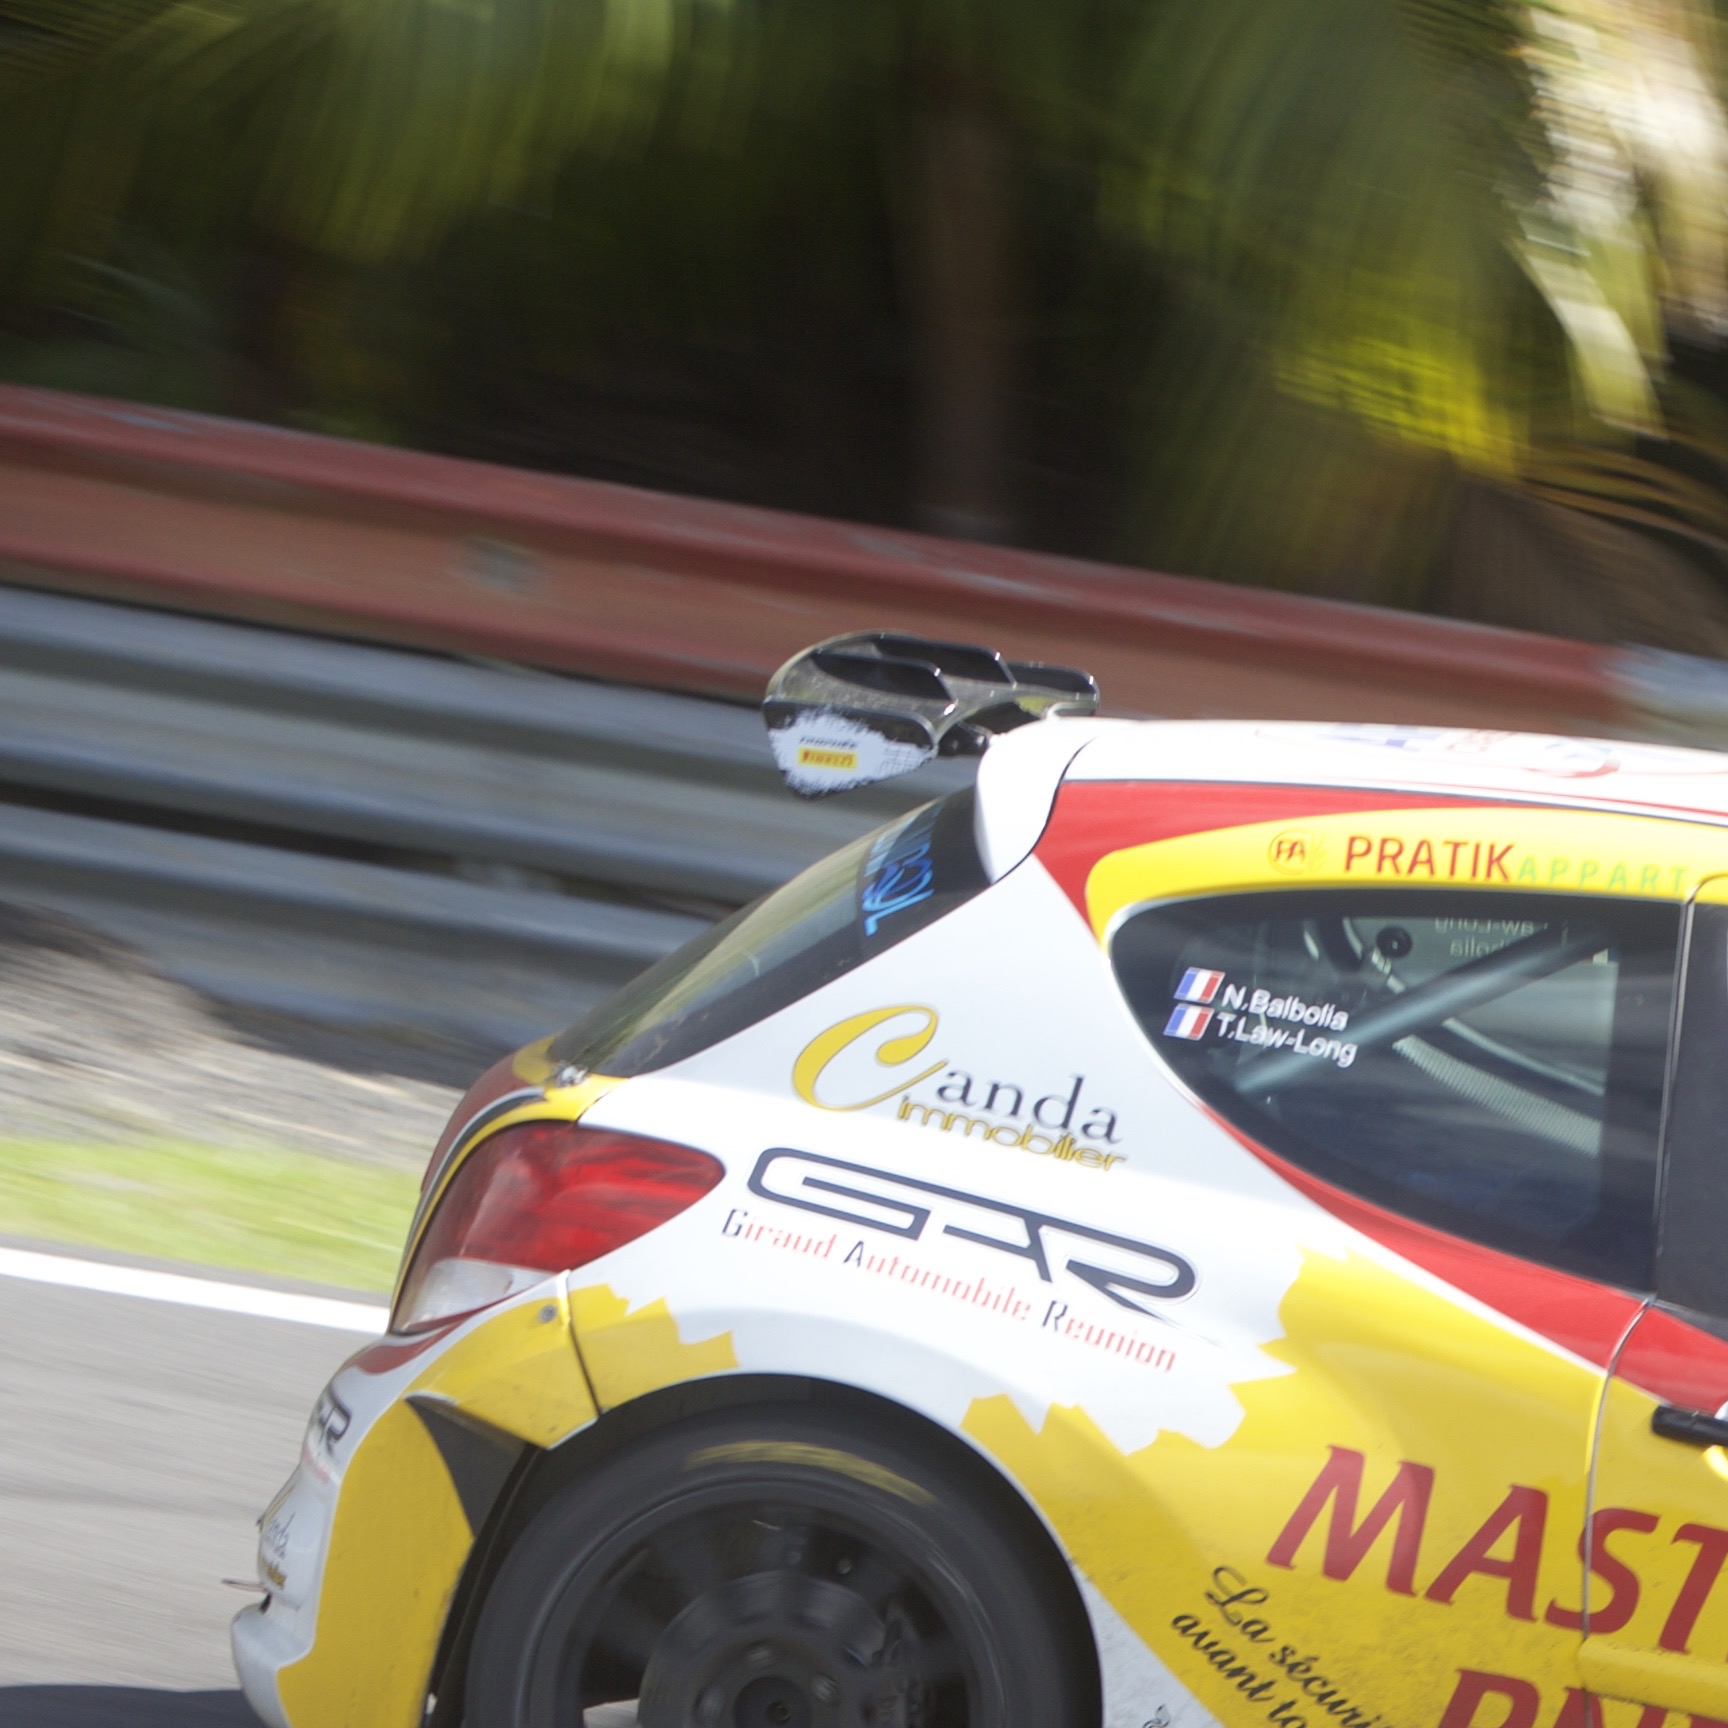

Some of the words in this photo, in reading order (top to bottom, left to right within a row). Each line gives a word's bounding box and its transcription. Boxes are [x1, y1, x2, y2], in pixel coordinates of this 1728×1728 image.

[1343, 835, 1516, 882] PRATIK
[1516, 857, 1691, 895] APPART
[790, 1003, 1122, 1146] Canda
[1216, 1011, 1358, 1069] T.Law-Long
[896, 1094, 1128, 1172] immobilier
[720, 1207, 840, 1263] Giraud
[842, 1239, 1034, 1326] Automobile
[1041, 1299, 1179, 1375] Reunion
[1204, 1565, 1277, 1643] La
[1170, 1614, 1276, 1702] avant
